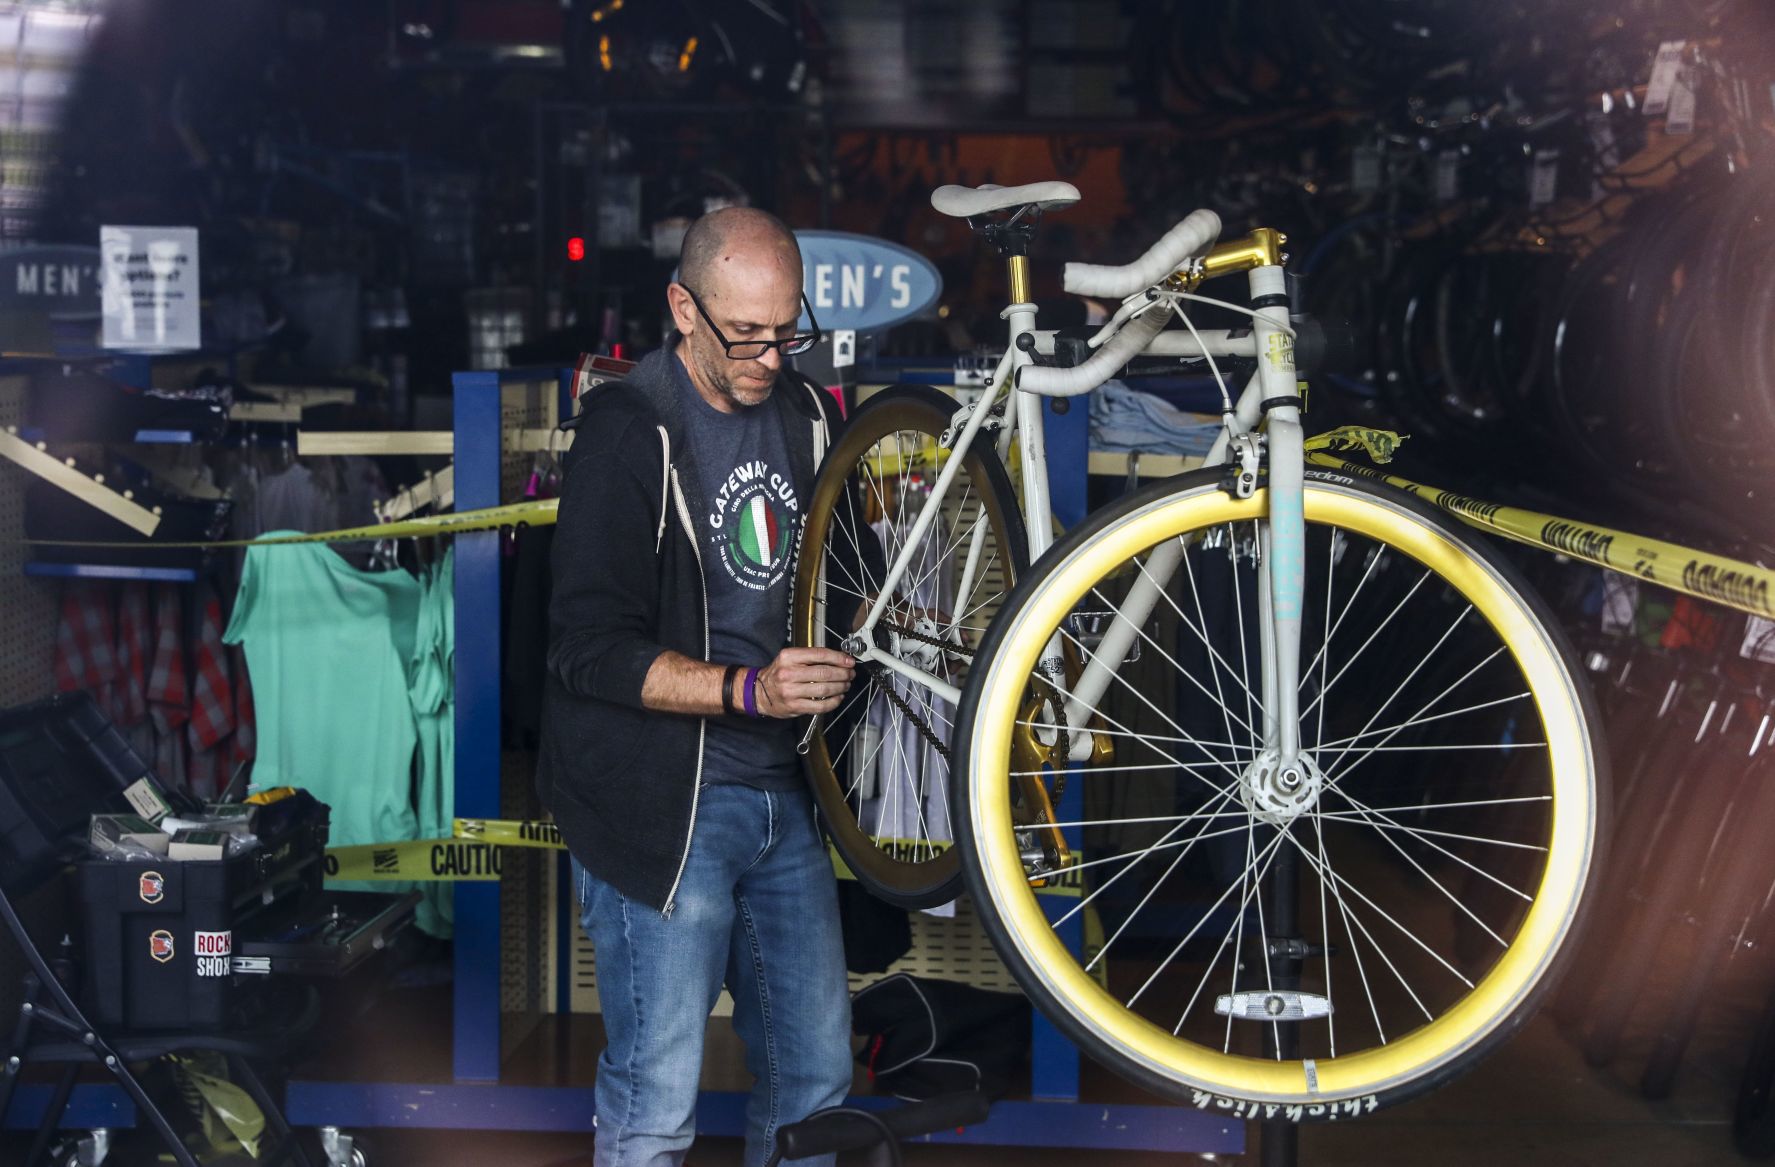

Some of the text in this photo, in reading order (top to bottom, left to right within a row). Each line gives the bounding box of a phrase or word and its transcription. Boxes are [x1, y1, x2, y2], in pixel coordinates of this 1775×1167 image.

[801, 263, 911, 309] EN'S
[1304, 469, 1354, 486] edom
[709, 460, 798, 529] GATEWAY CUP
[740, 483, 758, 498] DELLA
[431, 843, 502, 876] CAUTIO
[198, 934, 232, 953] ROCK
[196, 956, 231, 977] SHOX
